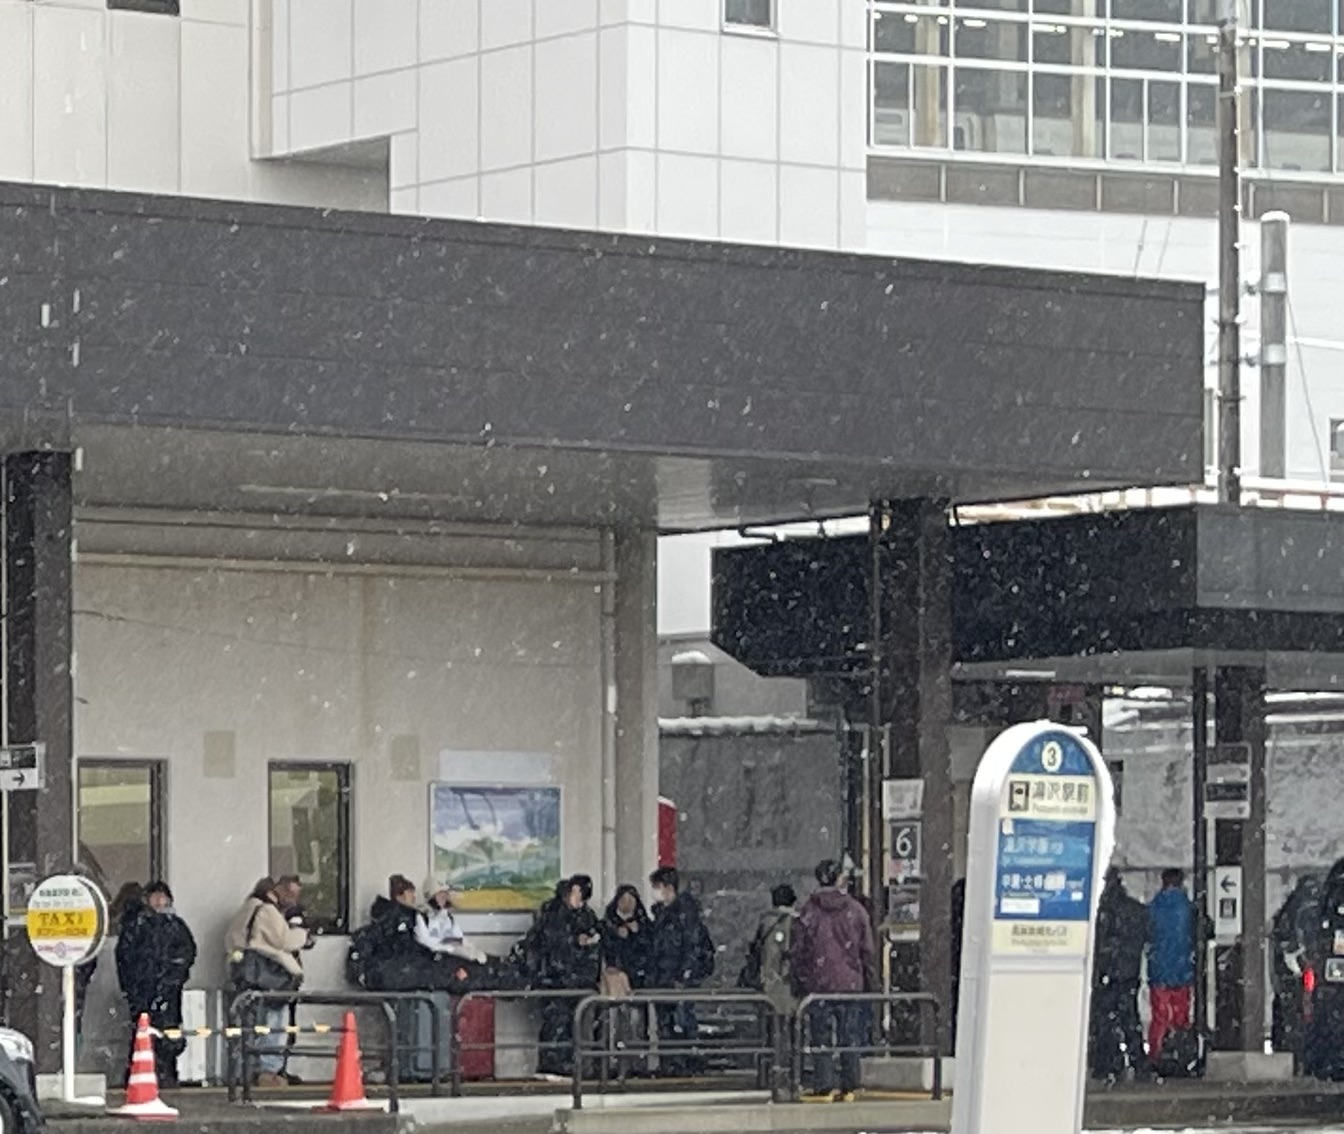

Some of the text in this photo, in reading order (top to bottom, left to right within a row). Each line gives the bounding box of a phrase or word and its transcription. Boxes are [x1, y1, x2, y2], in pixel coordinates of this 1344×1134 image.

[1047, 747, 1057, 766] 3
[895, 827, 913, 857] 6
[38, 912, 84, 926] TAXI
